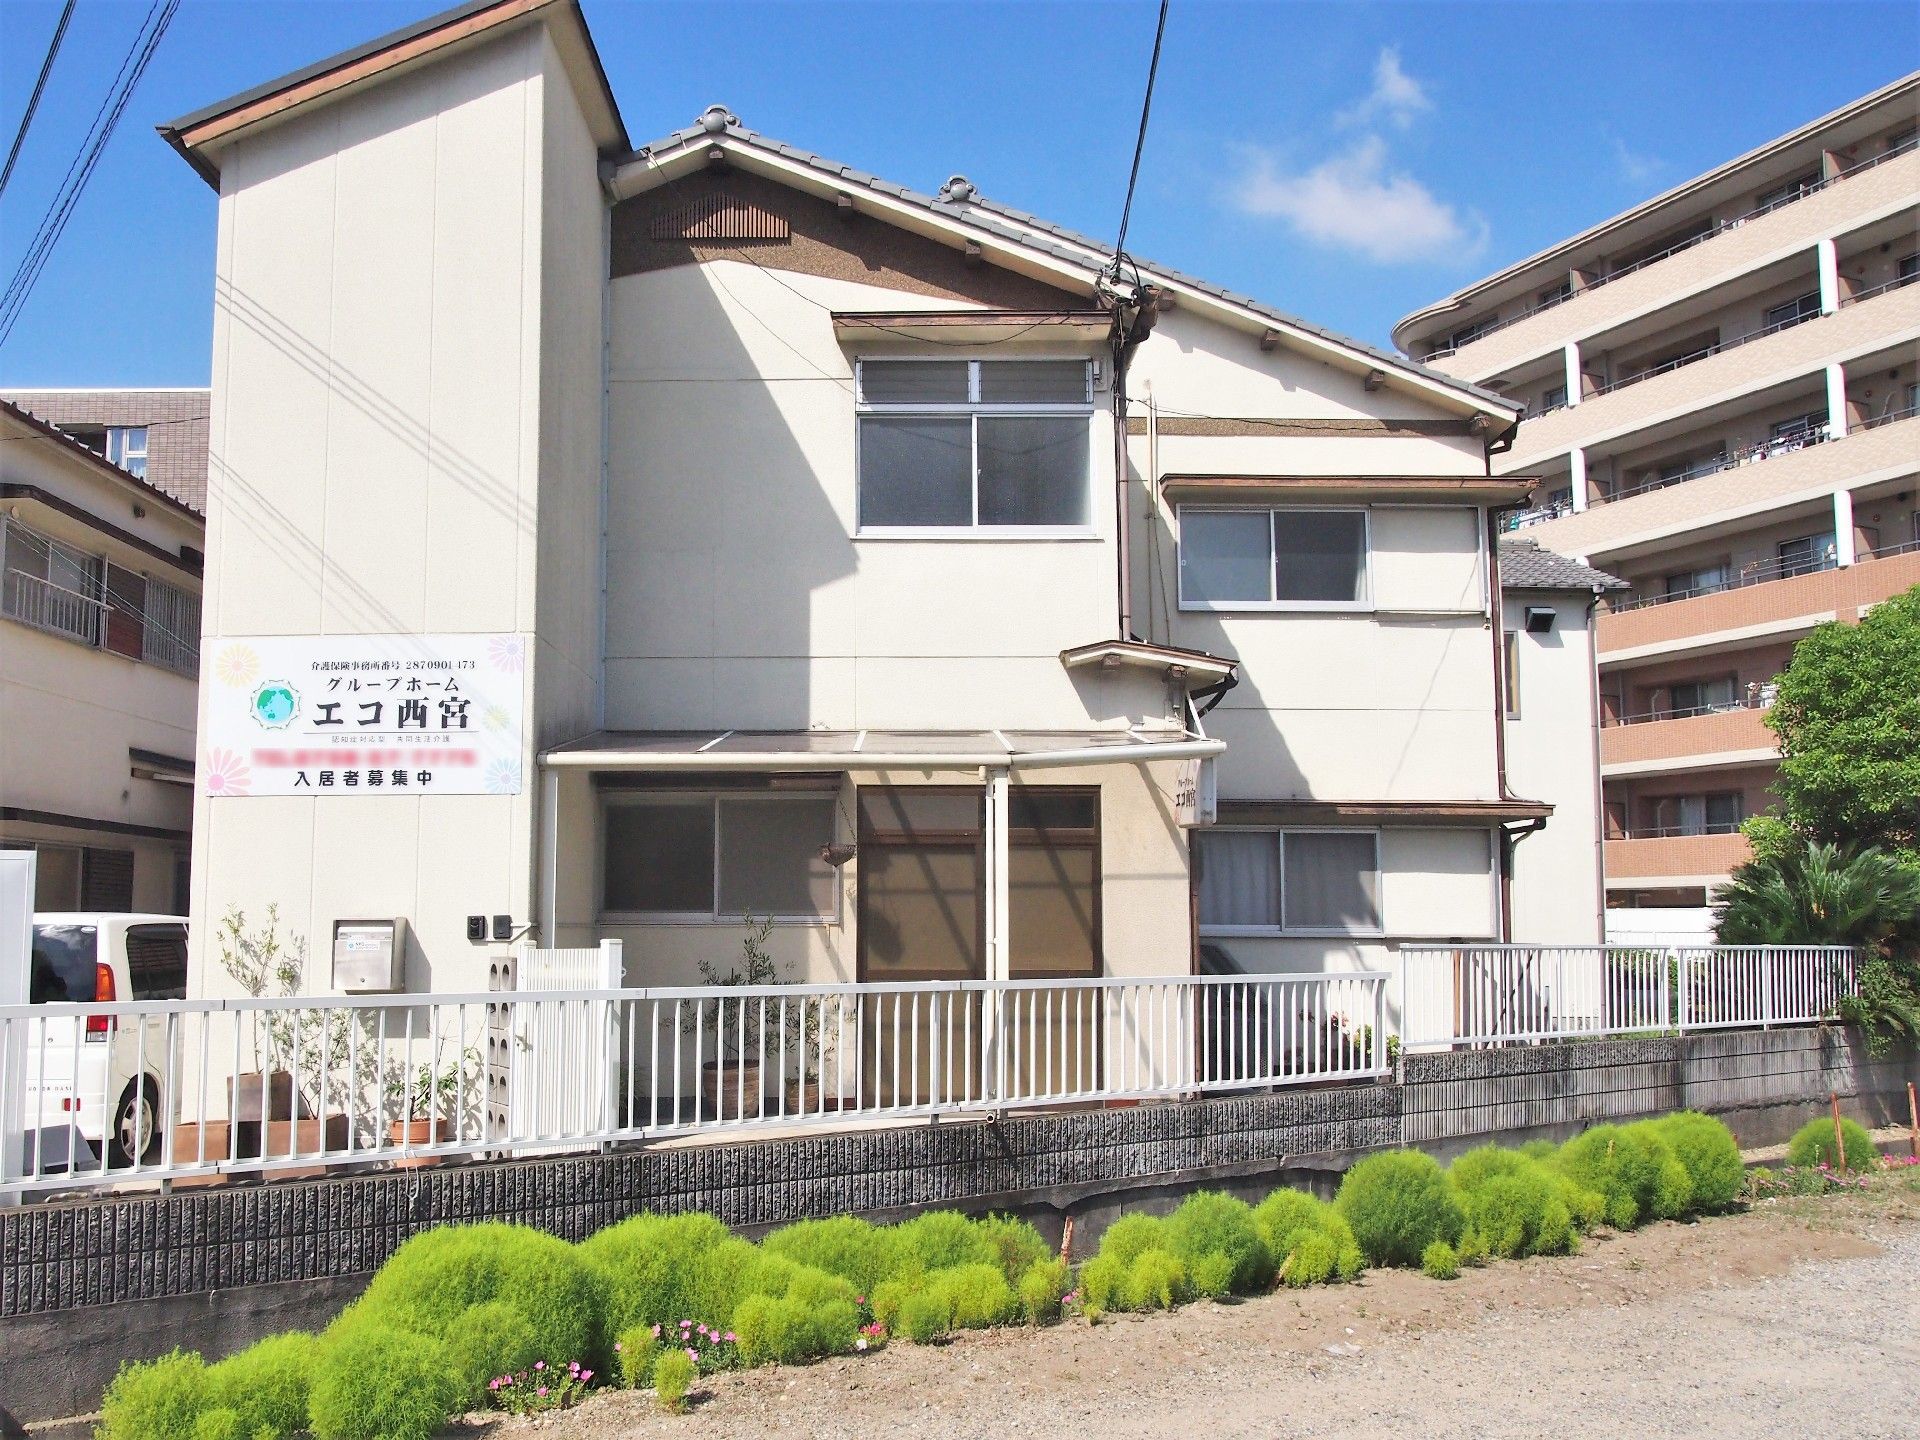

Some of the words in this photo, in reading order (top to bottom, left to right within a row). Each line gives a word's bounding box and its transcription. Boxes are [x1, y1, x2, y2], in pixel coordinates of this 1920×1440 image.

[326, 676, 460, 692] グループホーム
[312, 696, 471, 729] エコ西宮
[294, 769, 432, 786] 入居者募集中
